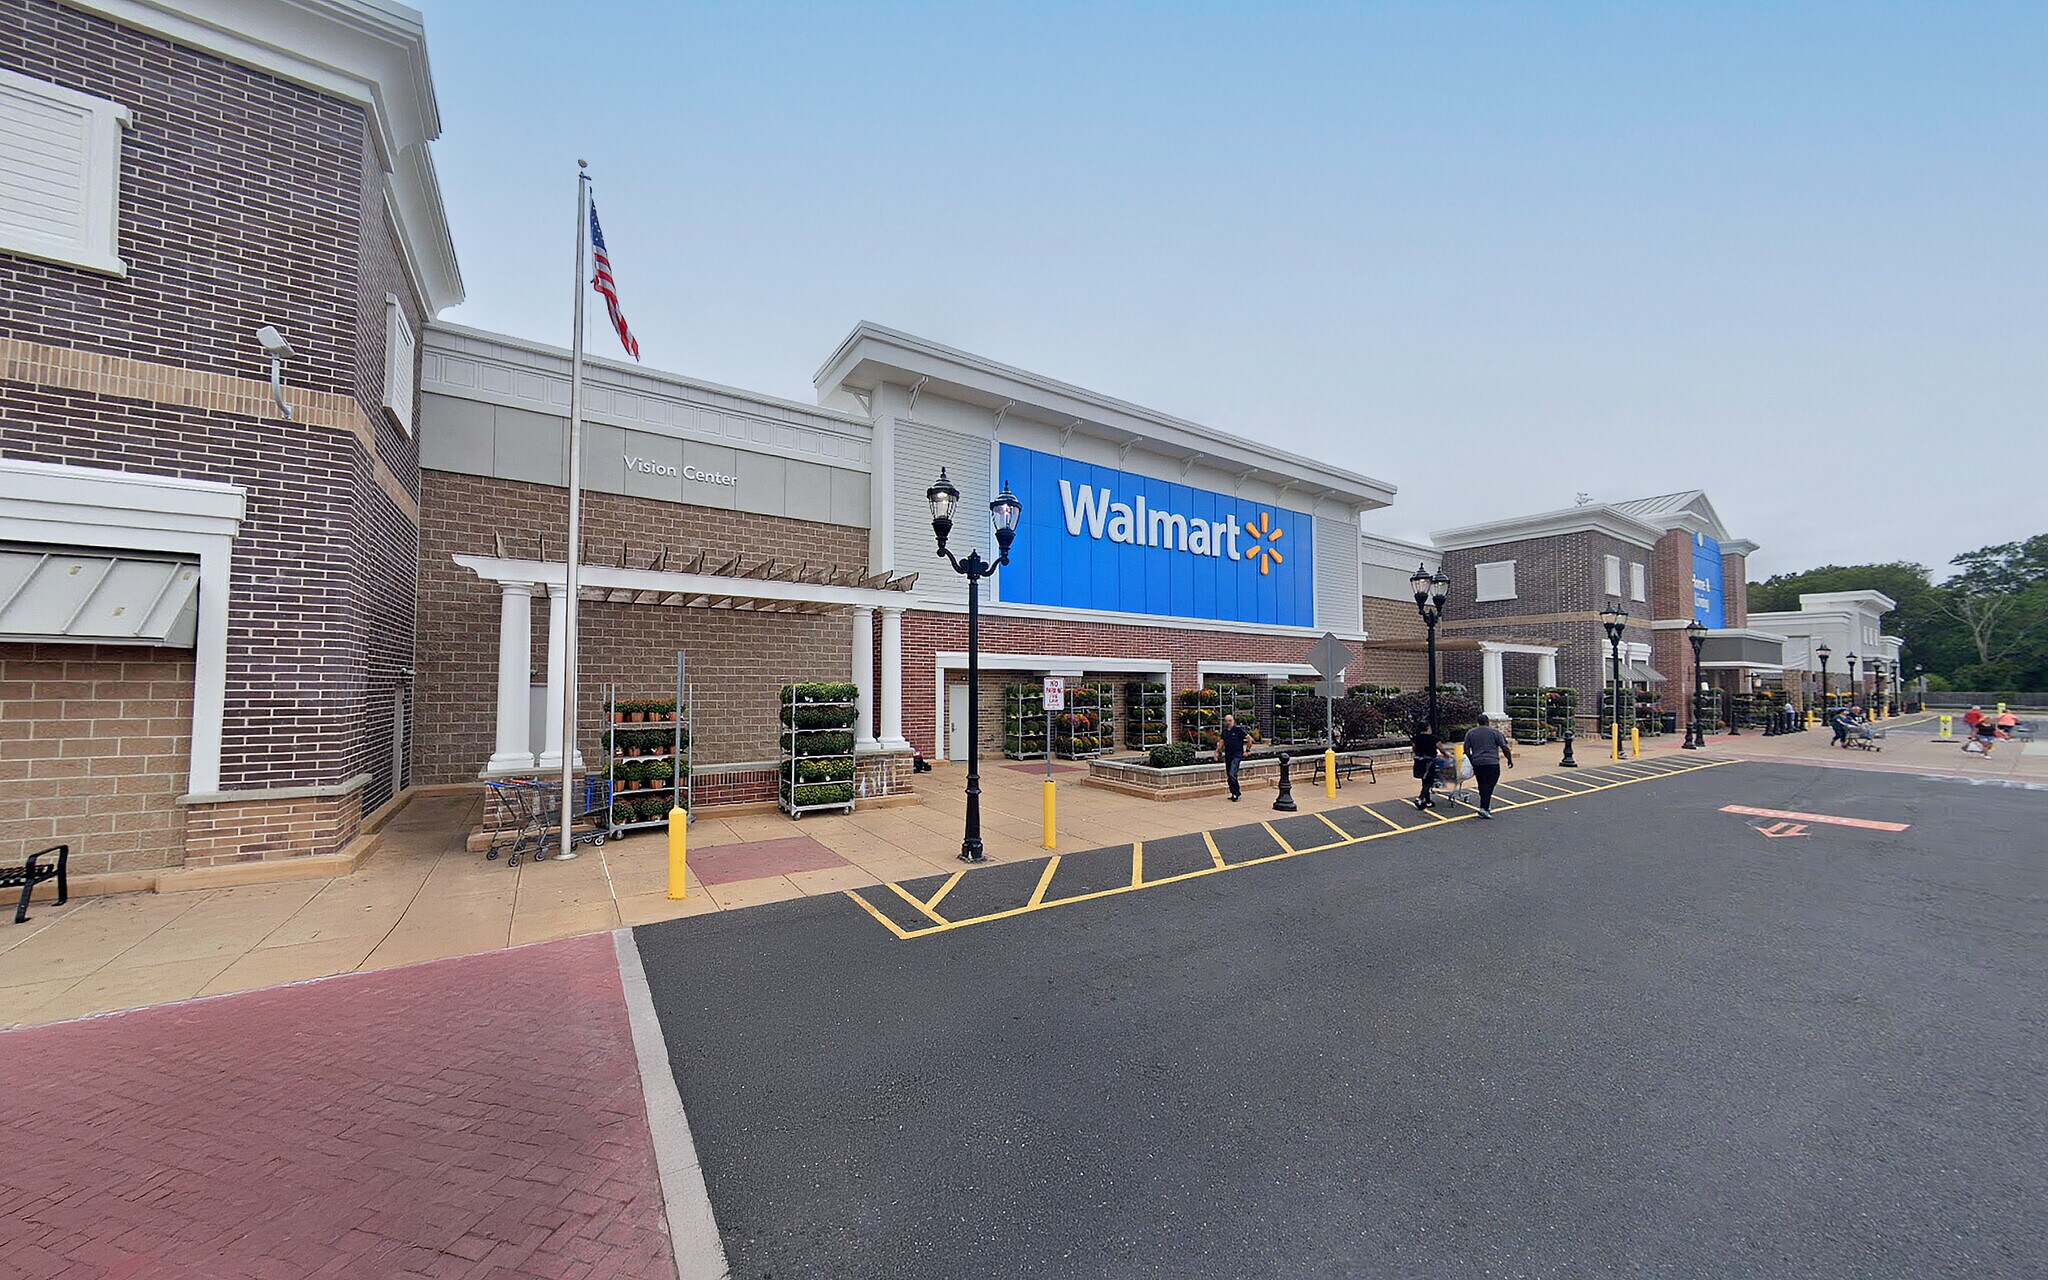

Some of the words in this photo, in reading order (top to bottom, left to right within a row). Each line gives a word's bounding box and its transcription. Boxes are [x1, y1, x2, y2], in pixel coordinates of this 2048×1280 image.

[623, 454, 677, 477] Vision
[683, 465, 738, 487] Center
[1058, 479, 1241, 561] Walmart
